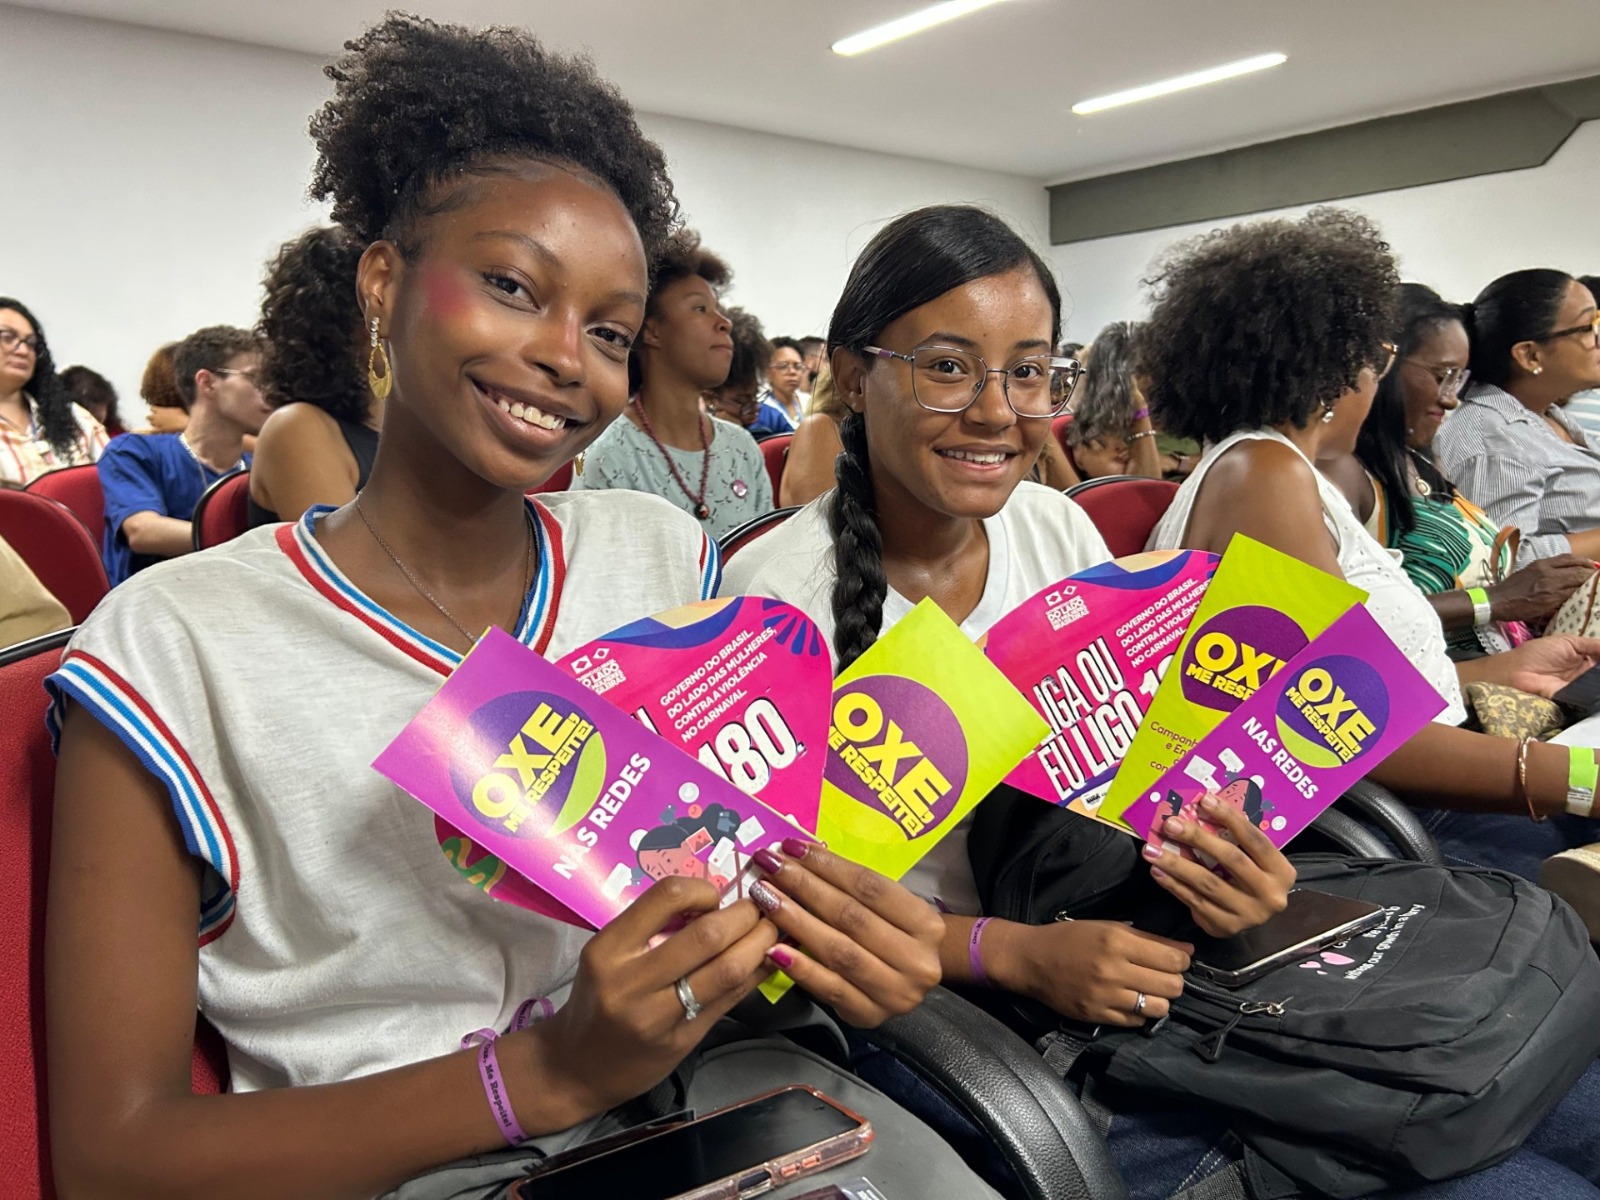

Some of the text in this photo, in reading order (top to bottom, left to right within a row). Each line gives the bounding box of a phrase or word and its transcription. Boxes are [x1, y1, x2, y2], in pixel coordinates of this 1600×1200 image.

[1116, 578, 1199, 637] GOVERNO DO BRASIL
[1120, 635, 1134, 647] DO
[1133, 619, 1156, 639] LADO
[1155, 607, 1172, 623] DAS
[660, 667, 706, 706] GOVERNO
[704, 655, 720, 671] DO
[719, 629, 754, 660] BRASIL
[1126, 631, 1160, 657] CONTRA
[1158, 626, 1167, 636] A
[1131, 627, 1188, 668] NO CARNAVAL
[1194, 632, 1287, 690] OX
[666, 626, 778, 719] DO LADO DAS MULHERES,
[674, 696, 714, 730] CONTRA
[712, 690, 722, 702] A
[718, 651, 768, 693] VIOLÊNCIA
[1033, 665, 1094, 735] IGA
[1075, 636, 1124, 703] OU
[1185, 663, 1213, 685] ME
[1285, 686, 1307, 709] ME
[681, 688, 748, 743] NO CARNAVAL
[1298, 667, 1377, 754] OXE,
[472, 702, 581, 819] OXE,
[833, 692, 953, 824] OXE,
[1037, 689, 1145, 801] EU LIGO
[1165, 742, 1173, 750] e
[1242, 716, 1319, 800] NAS REDES
[552, 826, 599, 880] NAS
[588, 753, 651, 830] REDES
[1368, 951, 1384, 964] our
[485, 1063, 494, 1080] Me
